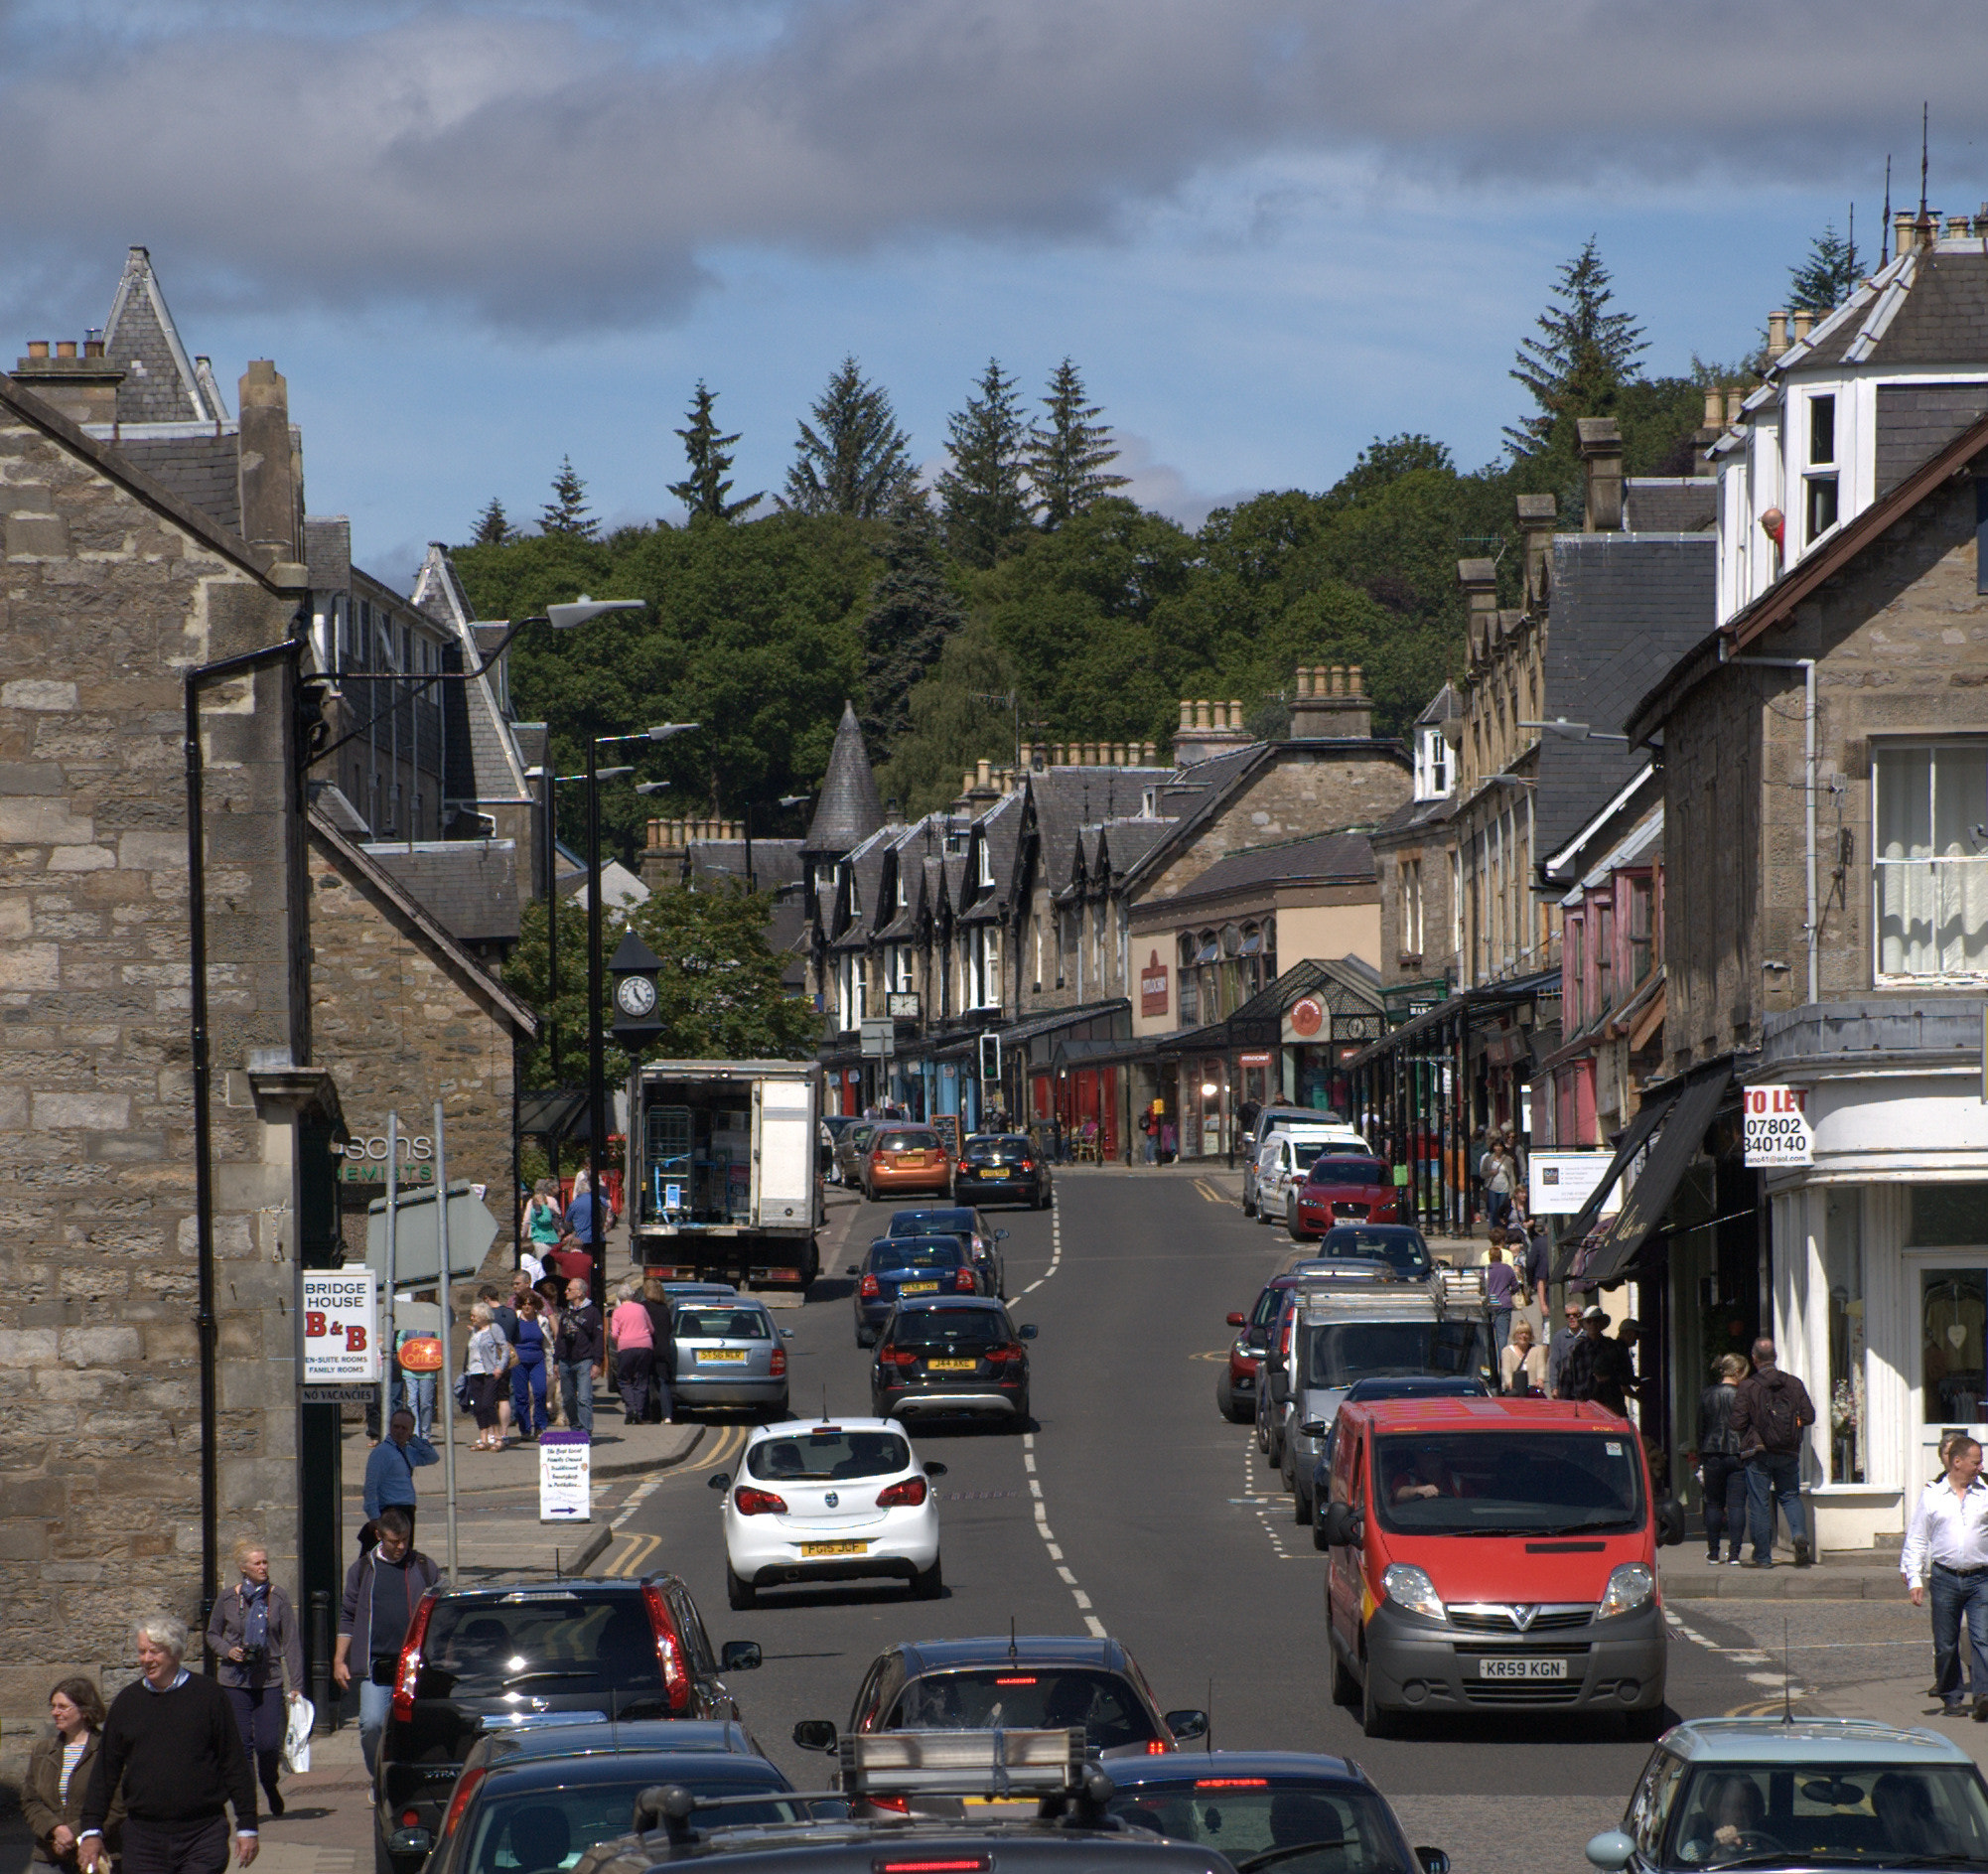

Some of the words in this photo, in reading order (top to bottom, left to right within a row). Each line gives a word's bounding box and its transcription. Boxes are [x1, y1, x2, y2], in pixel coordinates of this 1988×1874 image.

[1744, 1090, 1768, 1114] TO
[1773, 1088, 1809, 1112] LET
[1747, 1118, 1801, 1135] 07802
[305, 1283, 366, 1294] BRIDGE
[308, 1296, 364, 1308] HOUSE
[406, 1353, 442, 1365] Office
[304, 1390, 319, 1400] NO
[321, 1390, 372, 1400] VACANCIES
[1487, 1661, 1526, 1676] KR59
[1530, 1661, 1560, 1676] KGN
